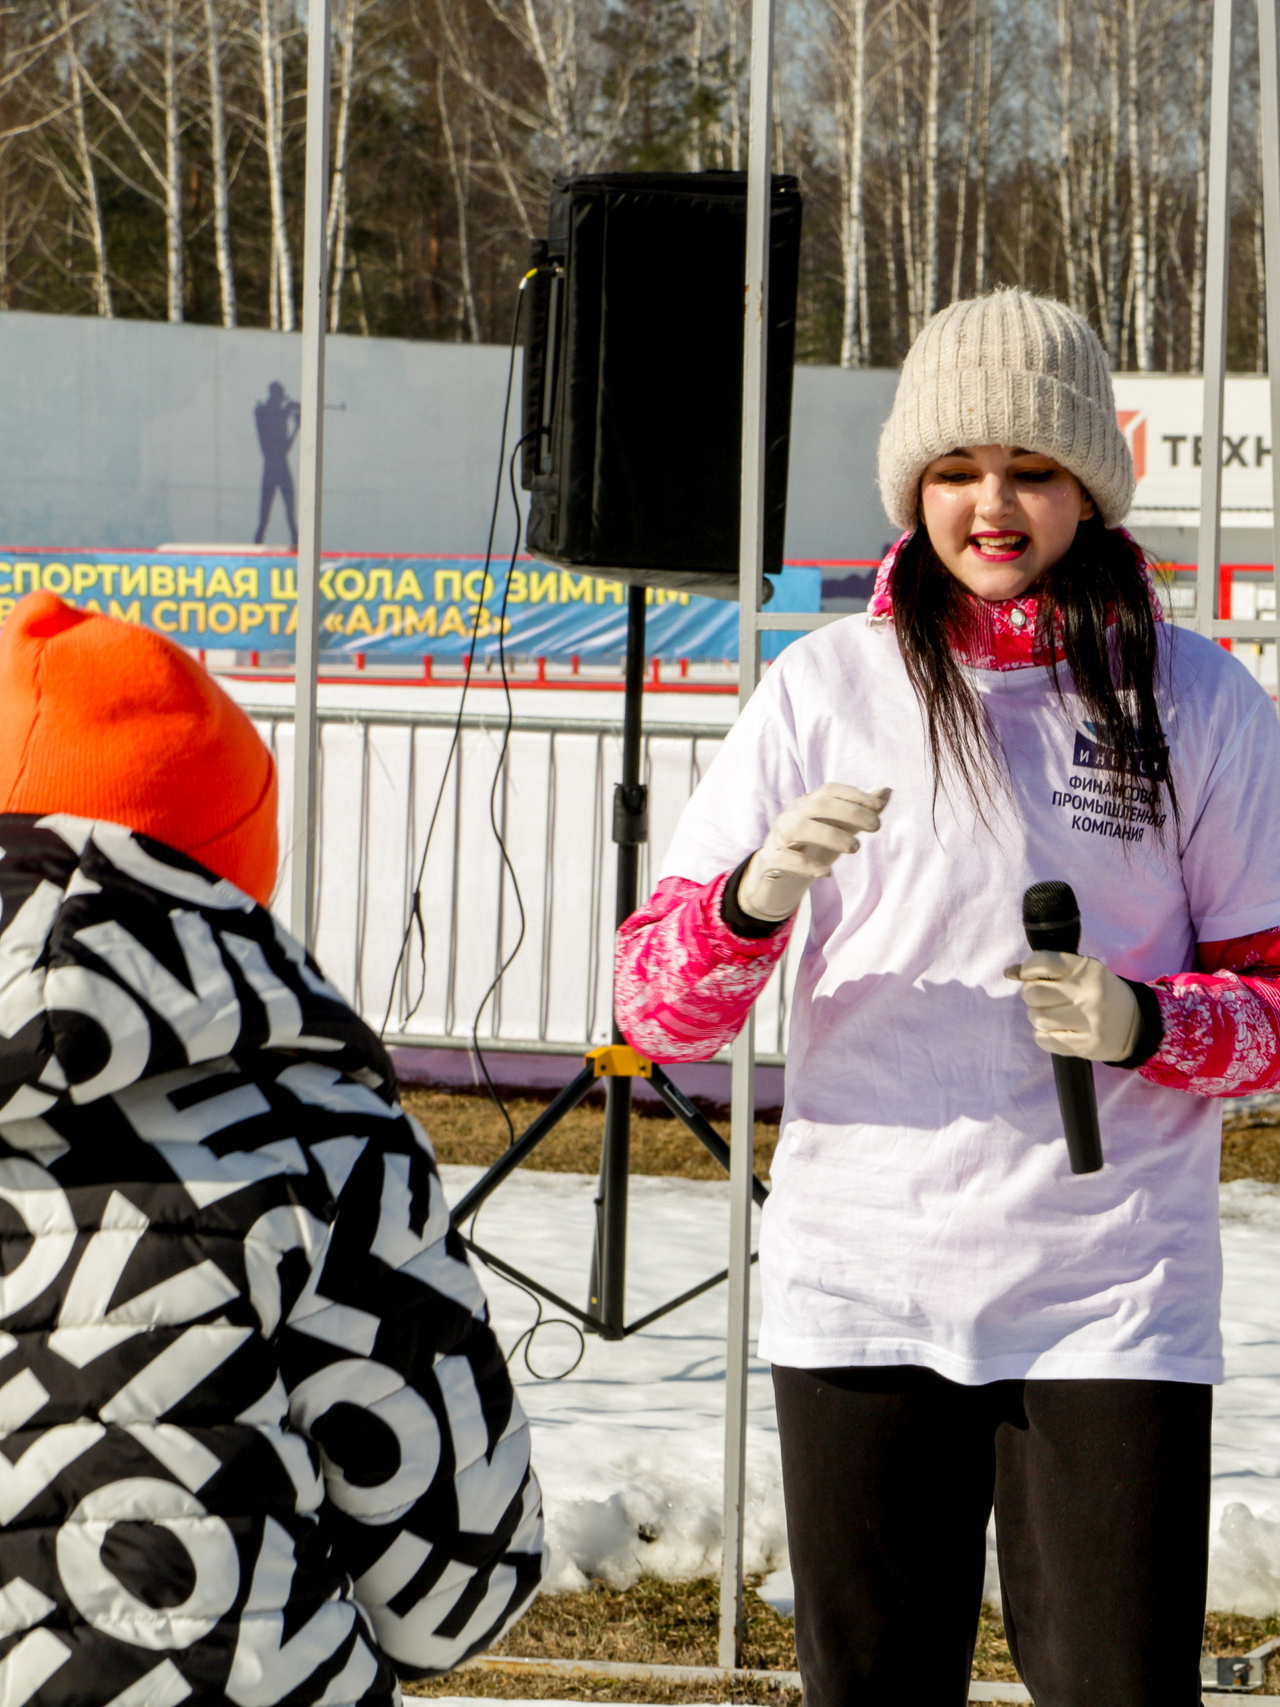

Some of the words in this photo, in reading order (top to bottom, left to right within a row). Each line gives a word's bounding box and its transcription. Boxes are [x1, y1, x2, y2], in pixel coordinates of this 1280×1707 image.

[0, 562, 258, 600] СПОРТИВНАЯ
[434, 568, 495, 603] ПО
[504, 570, 690, 606] ЗИМН
[323, 603, 512, 639] «АЛМАЗ»
[1052, 791, 1167, 829] ПРОМЫШЛЕННАЯ
[1072, 815, 1144, 843] КОМПАНИЯ
